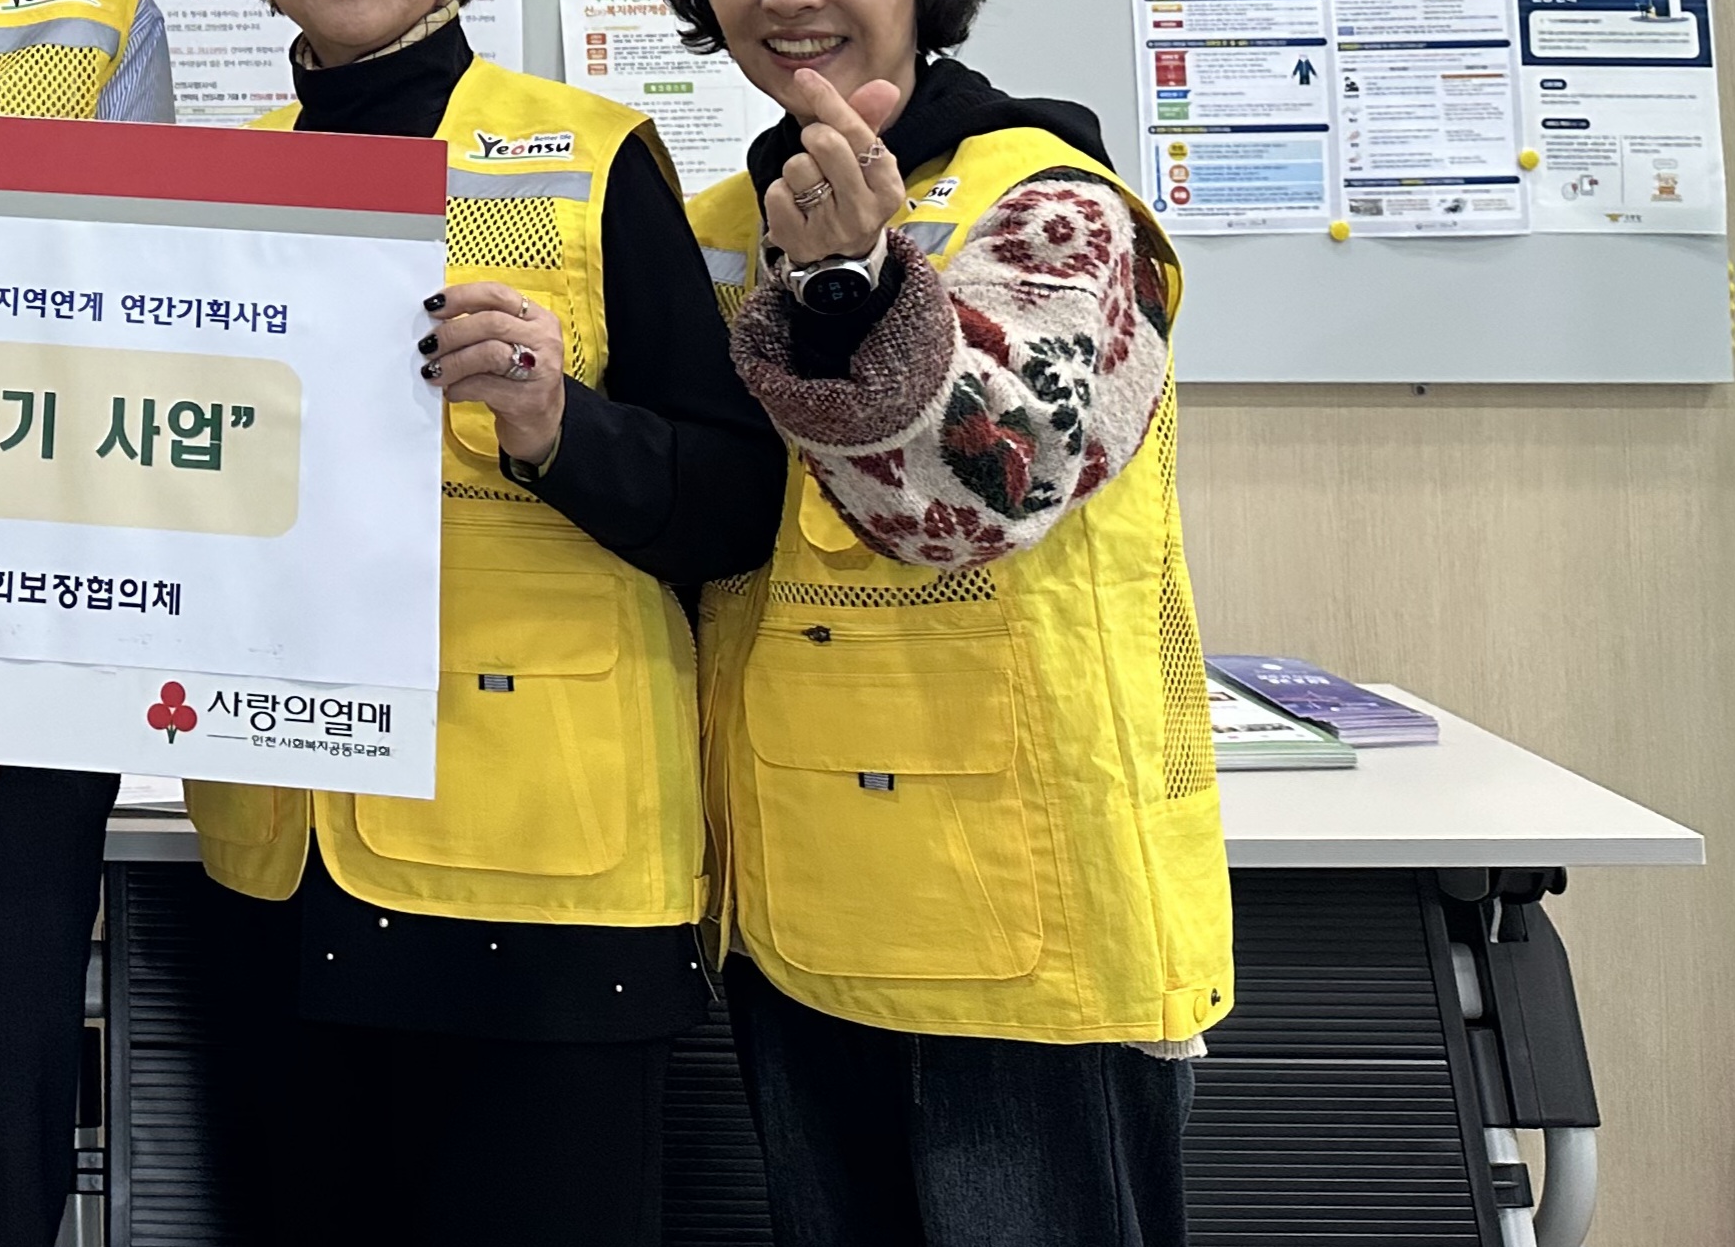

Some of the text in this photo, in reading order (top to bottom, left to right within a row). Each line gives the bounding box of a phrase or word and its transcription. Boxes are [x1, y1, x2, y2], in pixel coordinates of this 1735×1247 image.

[477, 133, 570, 157] Yeonsu
[121, 295, 289, 334] 연간기획사업
[97, 394, 256, 473] 사업”
[208, 691, 392, 737] 사랑의열매
[252, 735, 390, 756] 인천 사회복지공동모금회
